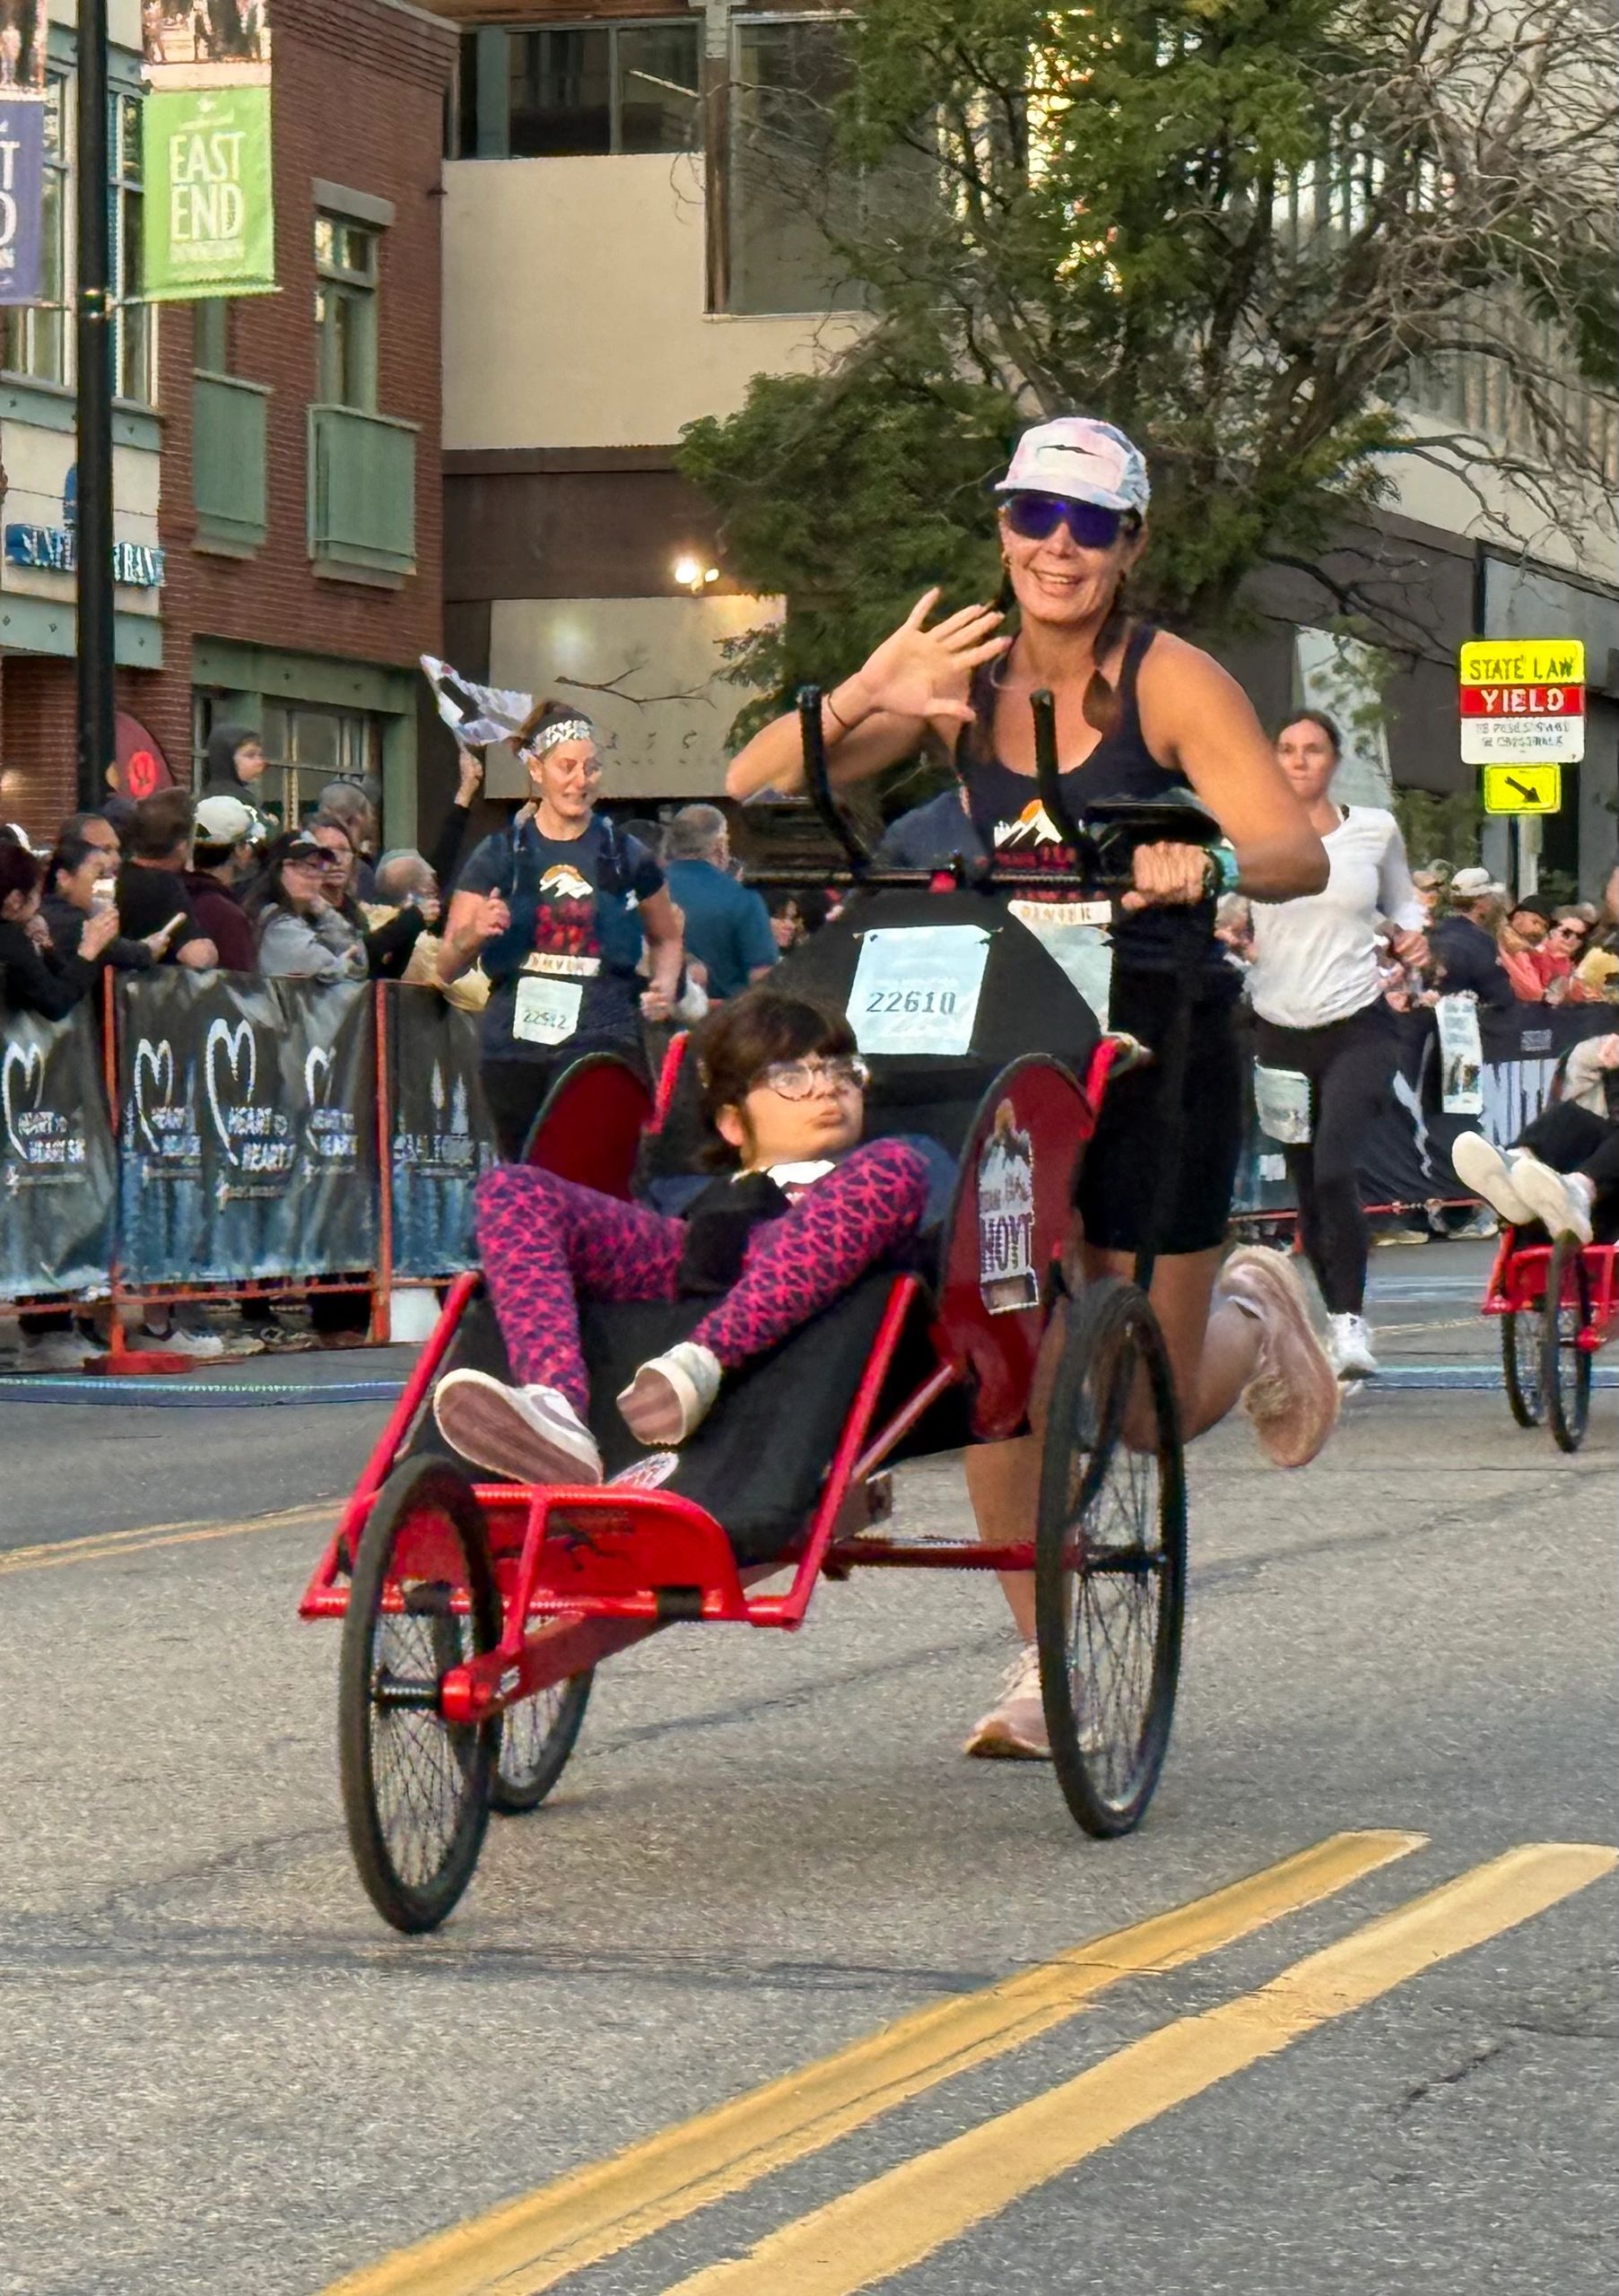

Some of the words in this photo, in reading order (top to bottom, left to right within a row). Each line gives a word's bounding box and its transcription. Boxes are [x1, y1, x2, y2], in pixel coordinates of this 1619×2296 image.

[169, 131, 246, 185] EAST
[170, 182, 245, 241] END
[1470, 657, 1525, 681] STATE
[1534, 656, 1576, 680] LAW
[1481, 687, 1565, 713] YIELD
[866, 990, 956, 1015] 22610
